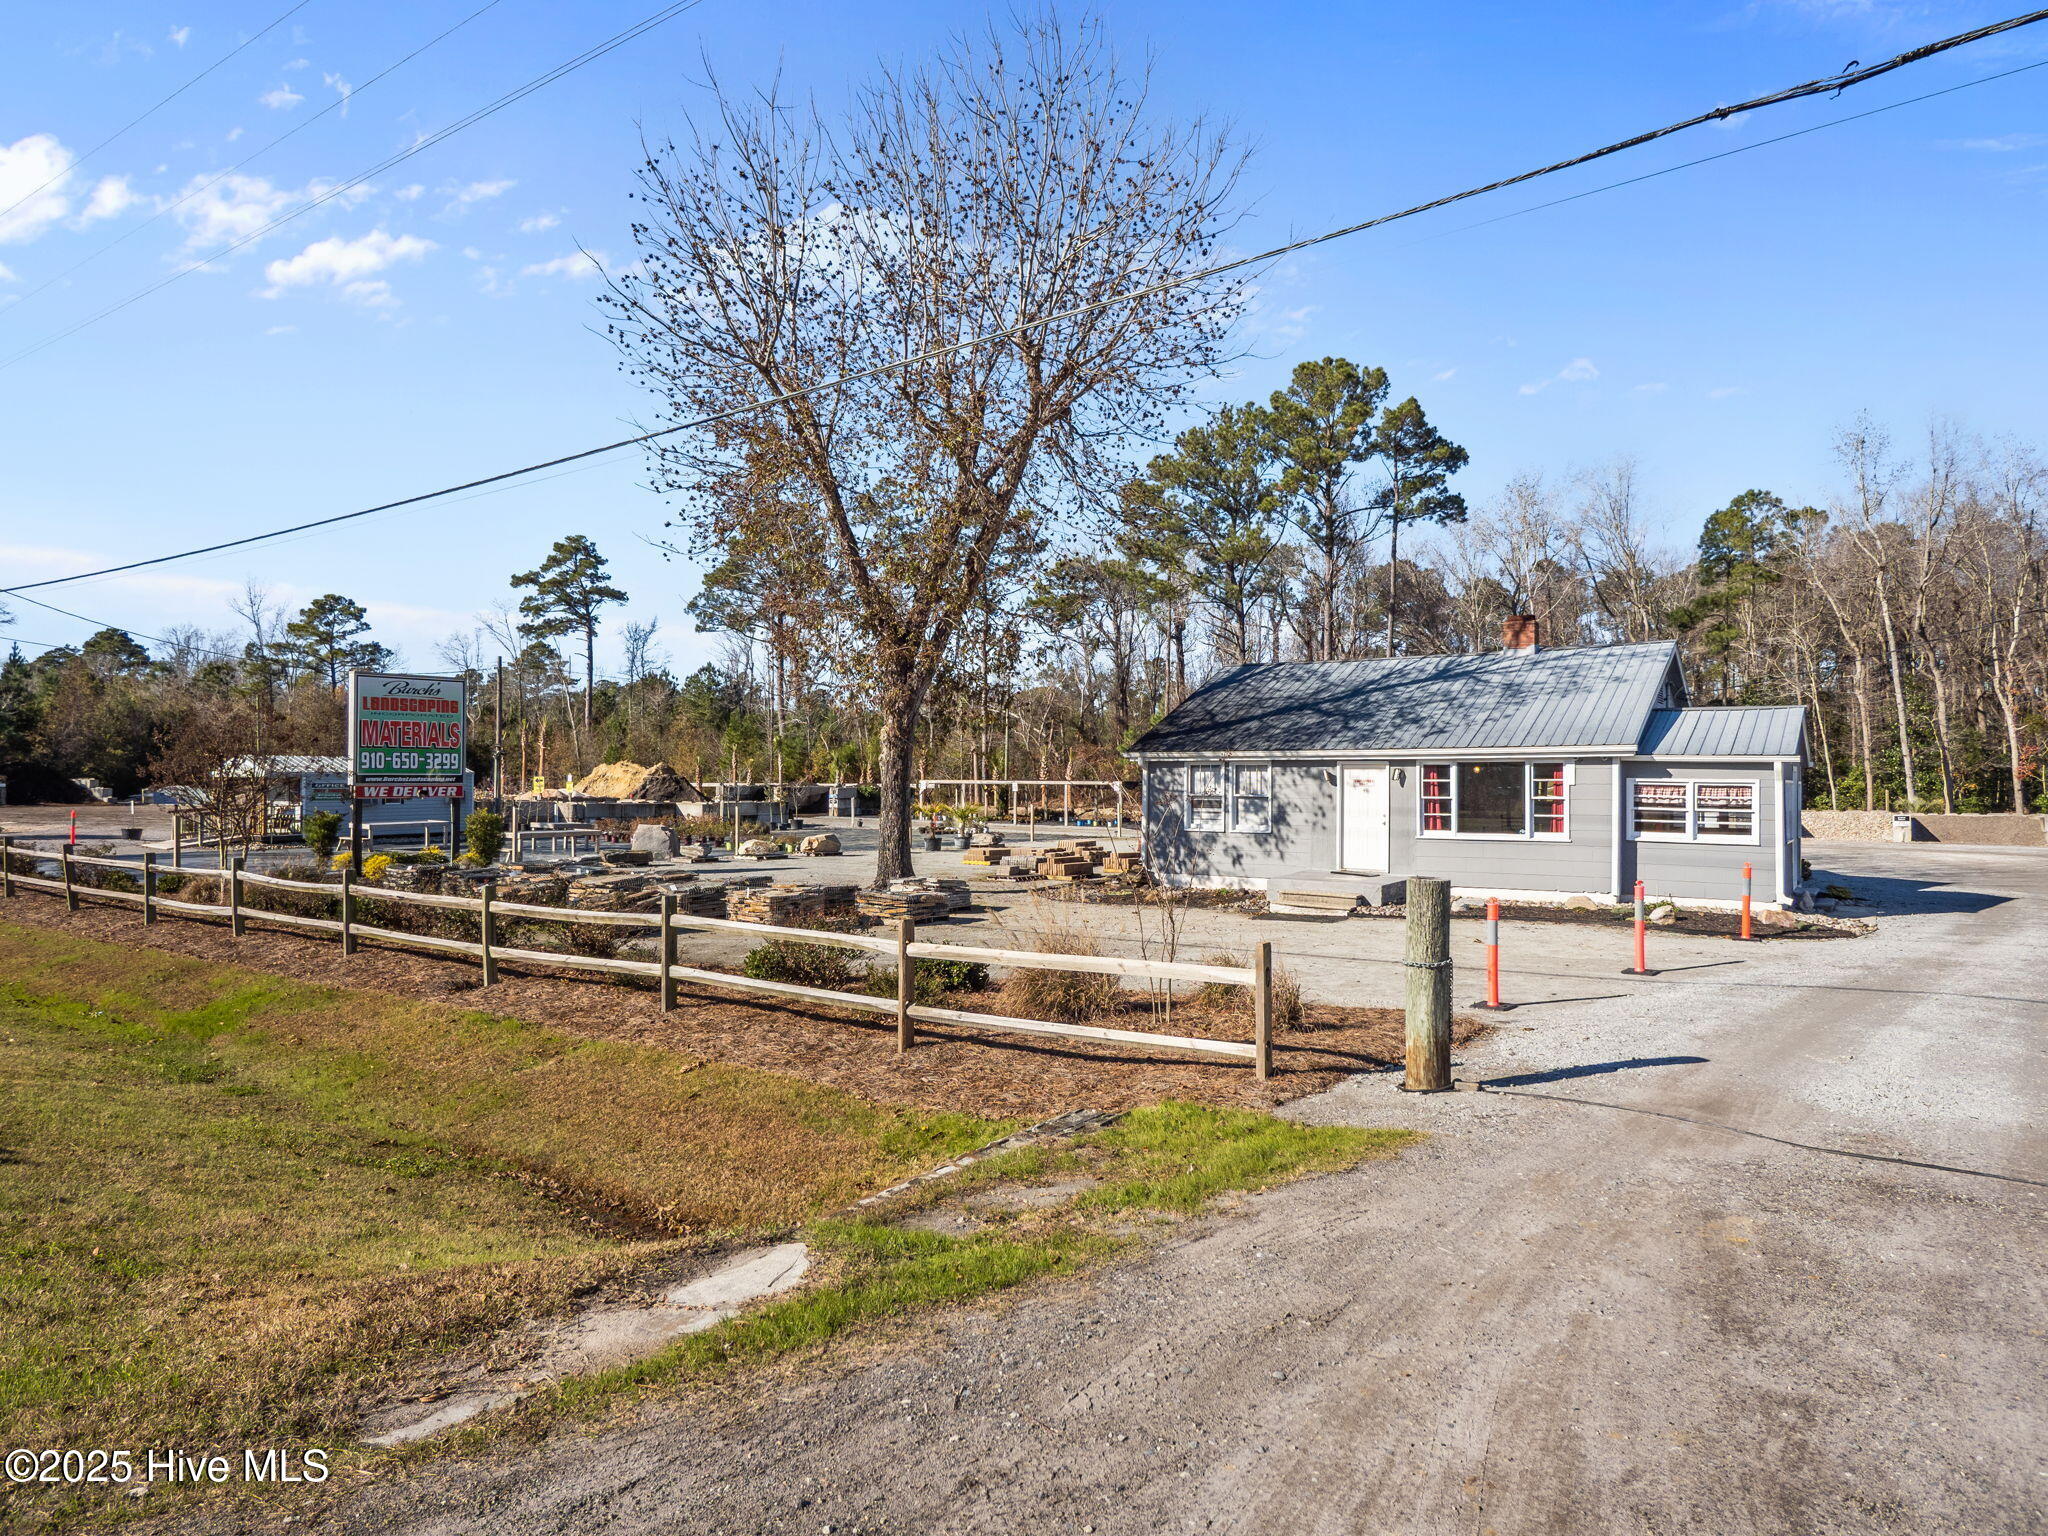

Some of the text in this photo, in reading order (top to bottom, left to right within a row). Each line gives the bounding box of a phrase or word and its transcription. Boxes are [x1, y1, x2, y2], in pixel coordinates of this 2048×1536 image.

[383, 680, 442, 696] Burch's
[360, 719, 461, 749] MATERIALS
[361, 752, 459, 770] 910-650-3299
[363, 786, 390, 797] WE
